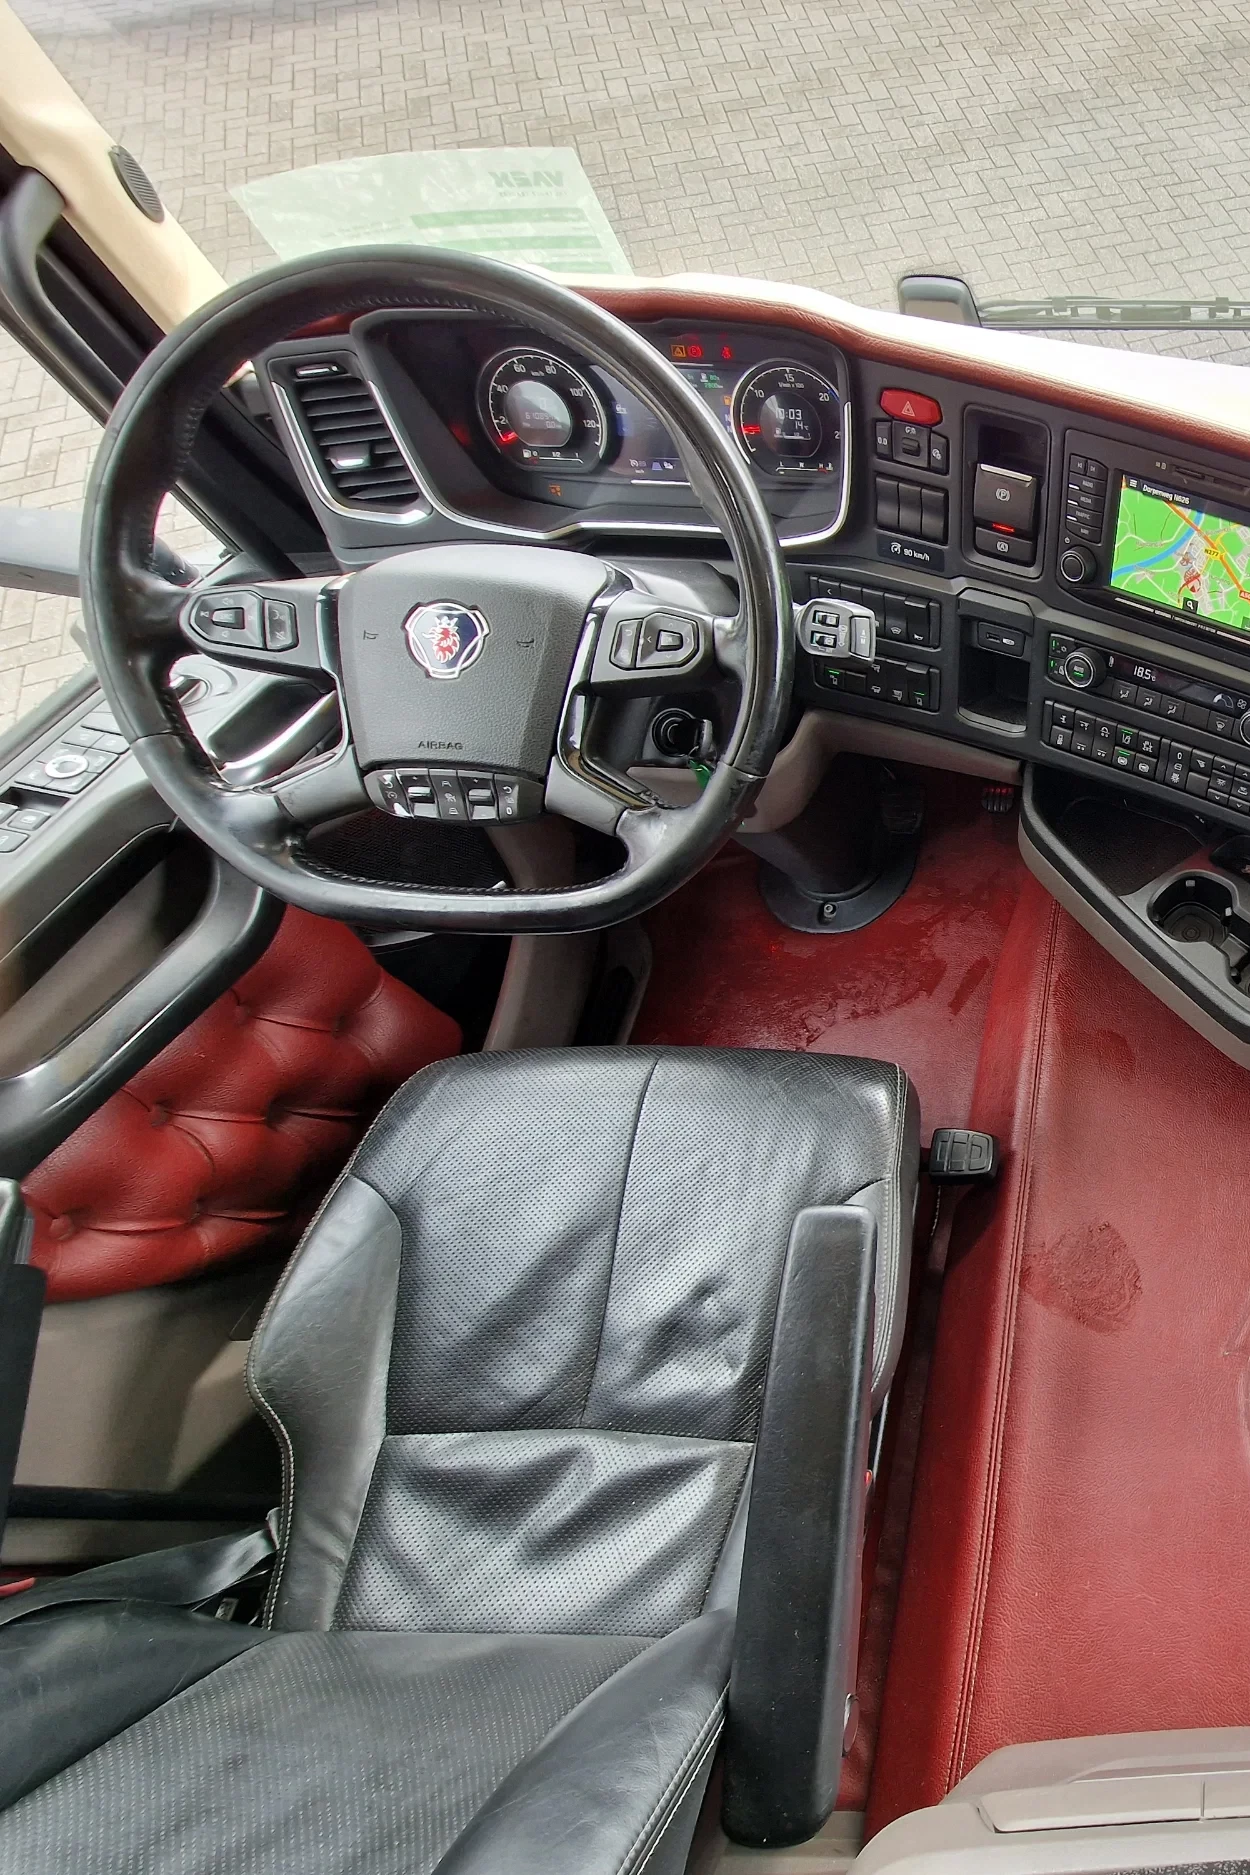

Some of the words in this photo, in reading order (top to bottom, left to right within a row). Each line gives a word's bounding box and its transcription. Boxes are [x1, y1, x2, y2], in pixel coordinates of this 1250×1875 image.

[513, 364, 526, 373] 60
[545, 365, 557, 375] 80
[784, 373, 795, 382] 15
[496, 385, 508, 394] 40
[569, 388, 584, 397] 100
[754, 389, 765, 398] 10
[819, 393, 830, 402] 20
[583, 419, 597, 429] 120
[904, 548, 912, 557] 90
[913, 550, 930, 561] km/h
[1204, 548, 1220, 557] N277
[418, 740, 464, 750] AIRBAG
